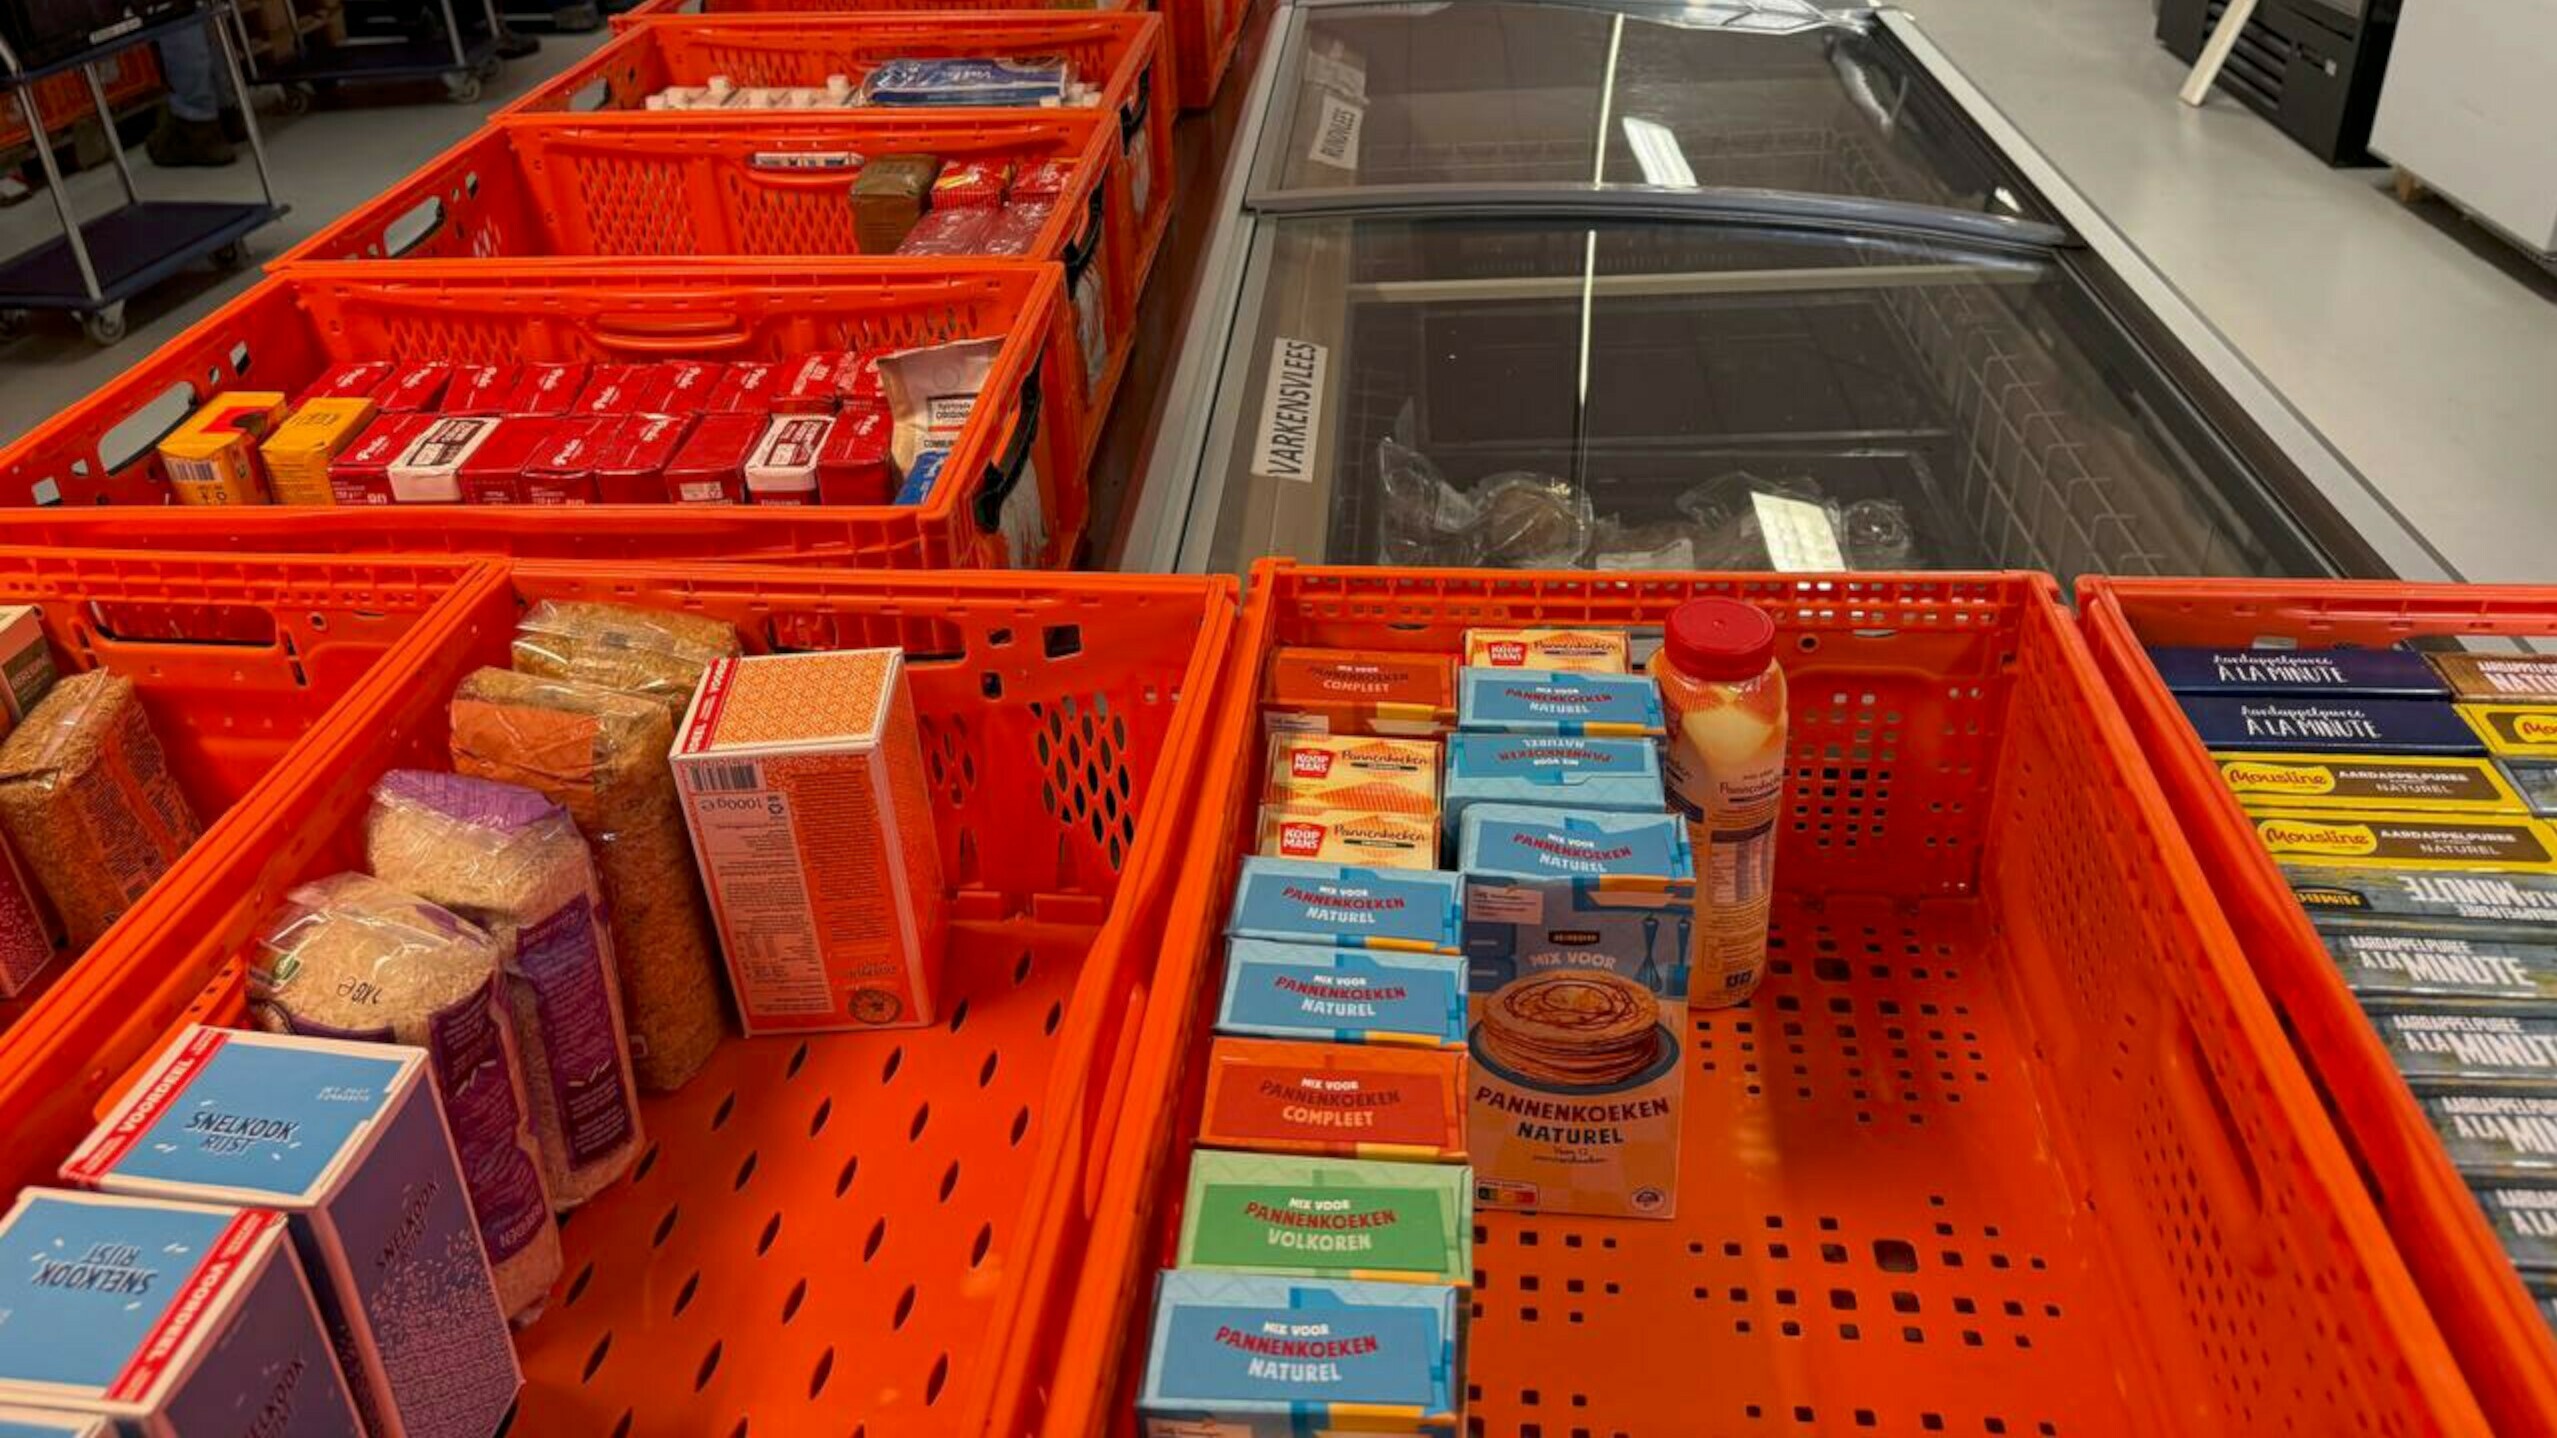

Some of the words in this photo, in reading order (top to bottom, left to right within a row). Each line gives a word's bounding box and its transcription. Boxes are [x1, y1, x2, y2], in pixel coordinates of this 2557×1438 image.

[1266, 341, 1316, 474] VARKENSVLEES
[2236, 665, 2267, 682] LA
[2266, 665, 2349, 683] MINUTE
[1323, 679, 1390, 693] COMPLEET
[1505, 687, 1612, 703] PANNENKOEKEN
[1529, 701, 1590, 713] NATUREL
[2265, 718, 2298, 738] LA
[2297, 718, 2382, 740] MINUTE
[1523, 739, 1585, 749] NATUREL
[1294, 753, 1329, 765] KOOP
[1497, 748, 1613, 762] PANNENKOEKEN
[1294, 763, 1328, 774] MANS
[2230, 769, 2326, 786] Mousline
[2376, 783, 2453, 794] NATUREL
[1284, 826, 1320, 839] KOOP
[1548, 833, 1565, 844] MIX
[1568, 836, 1595, 848] VOOR
[2266, 827, 2369, 845] Mousline
[1283, 836, 1319, 850] MANS
[1513, 832, 1632, 861] PANNENKOEKEN
[2420, 843, 2503, 856] NATUREL
[1539, 853, 1607, 873] NATUREL
[1282, 885, 1405, 910] PANNENKOEKEN
[1319, 885, 1337, 896] MIX
[1340, 886, 1368, 897] VOOR
[2396, 875, 2527, 907] MINUTE
[1306, 906, 1376, 924] NATUREL
[1530, 952, 1562, 966] MIX
[1567, 950, 1617, 970] VOOR
[2360, 950, 2378, 969] A
[2373, 950, 2404, 970] LA
[2397, 950, 2537, 987] MINUTE
[1274, 975, 1406, 1001] PANNENKOEKEN
[1313, 974, 1333, 985] MIX
[1336, 976, 1367, 987] VOOR
[1300, 998, 1376, 1017] NATUREL
[2403, 1031, 2424, 1051] A
[2418, 1031, 2451, 1052] LA
[1259, 1079, 1400, 1107] PANNENKOEKEN
[1301, 1077, 1323, 1089] MIX
[1326, 1079, 1359, 1092] VOOR
[117, 1055, 196, 1134] VOORDEEL
[1475, 1086, 1670, 1123] PANNENKOEKEN
[1282, 1105, 1374, 1127] COMPLEET
[184, 1110, 300, 1142] SNELKOOK
[1517, 1121, 1624, 1145] NATUREL
[1288, 1197, 1311, 1209] MIX
[1314, 1198, 1350, 1211] VOOR
[1245, 1201, 1397, 1231] PANNENKOEKEN
[1266, 1227, 1373, 1251] VOLKOREN
[31, 1259, 158, 1295] SNELKOOK
[145, 1258, 233, 1362] VOORDEEL
[1262, 1320, 1288, 1335] MIX
[1291, 1322, 1331, 1337] VOOR
[1214, 1325, 1379, 1359] PANNENKOEKEN
[1247, 1356, 1342, 1382] NATUREL
